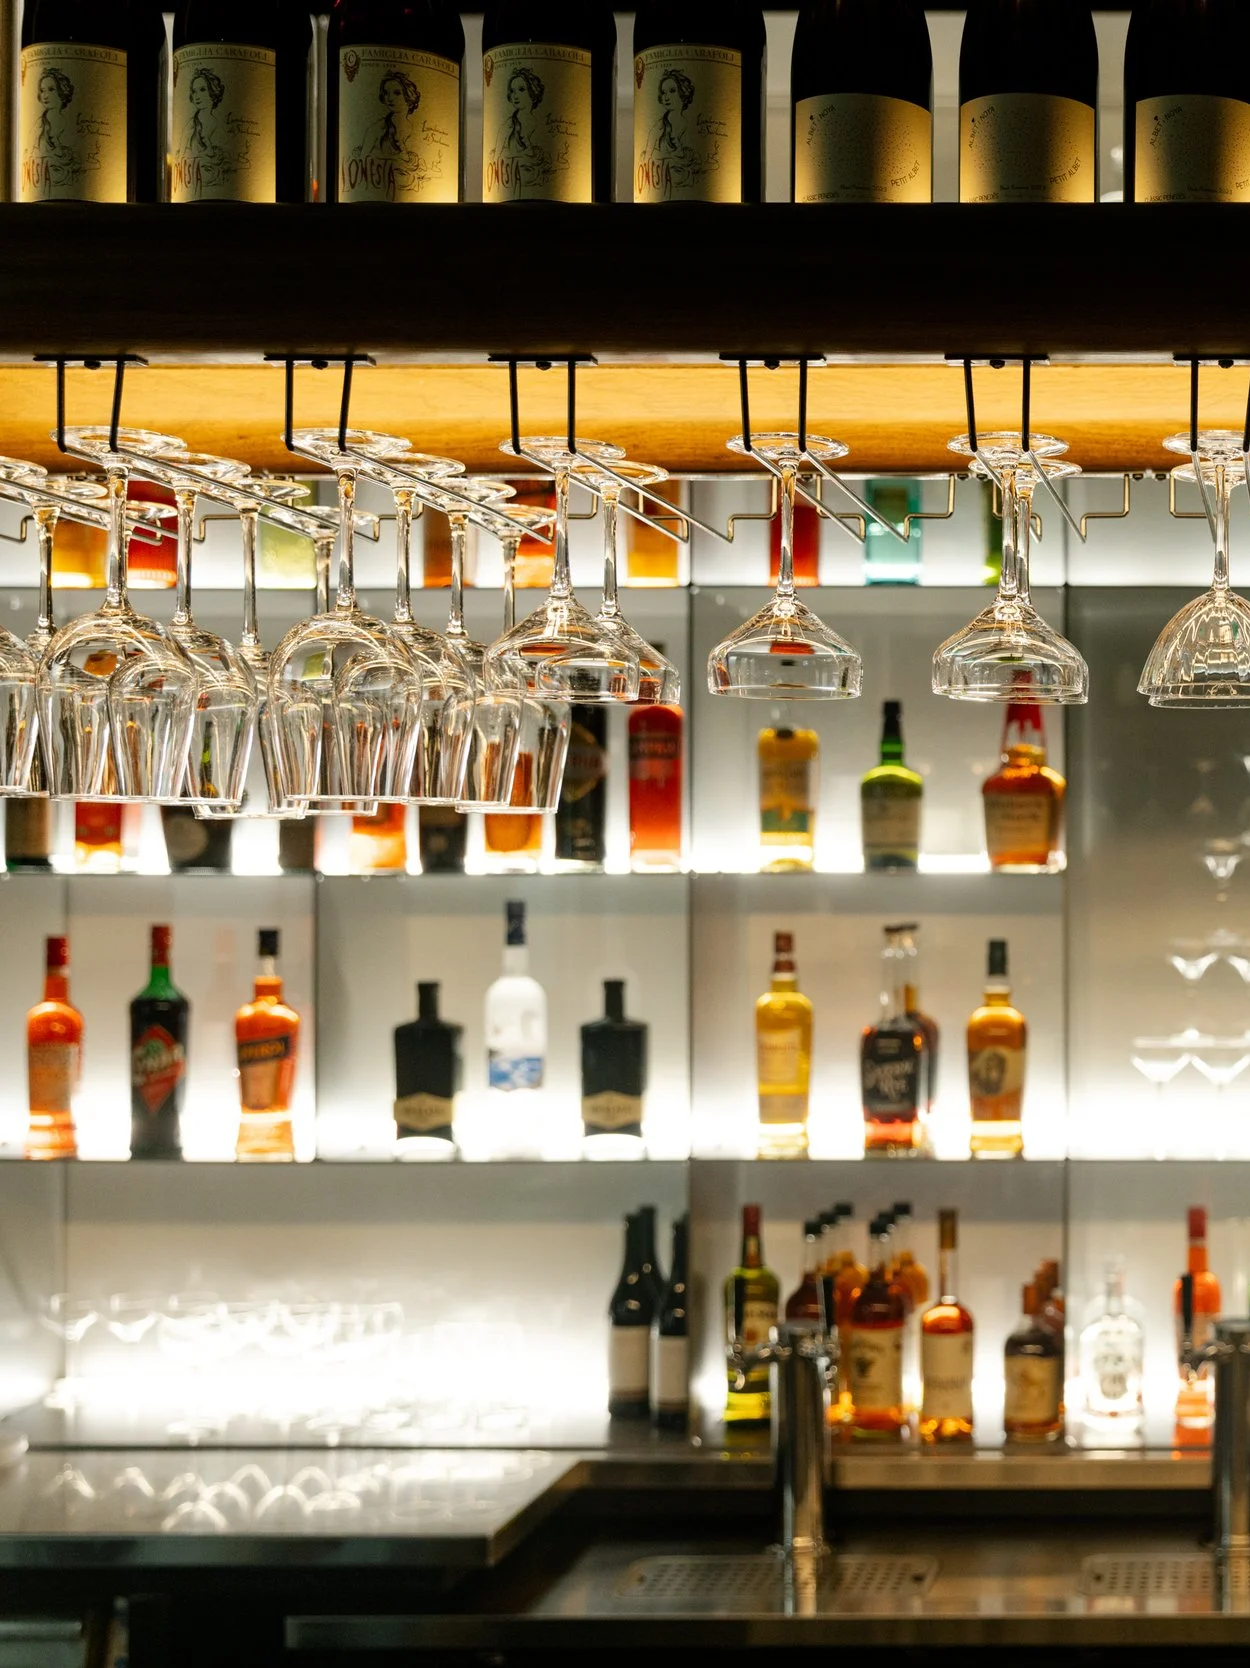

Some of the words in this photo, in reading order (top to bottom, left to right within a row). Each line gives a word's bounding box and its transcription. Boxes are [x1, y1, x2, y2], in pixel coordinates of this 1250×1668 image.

[361, 49, 410, 60] FAMIGLIA
[645, 47, 683, 62] FAMIGLIA
[819, 105, 837, 120] NOYA
[1150, 121, 1163, 147] ALBET
[1164, 105, 1183, 121] NOYA
[968, 124, 978, 149] ALBET
[980, 105, 996, 121] NOYA
[890, 175, 909, 187] PETIT
[908, 160, 921, 181] ALBET
[1049, 174, 1068, 185] PETIT
[1069, 157, 1081, 178] ALBET
